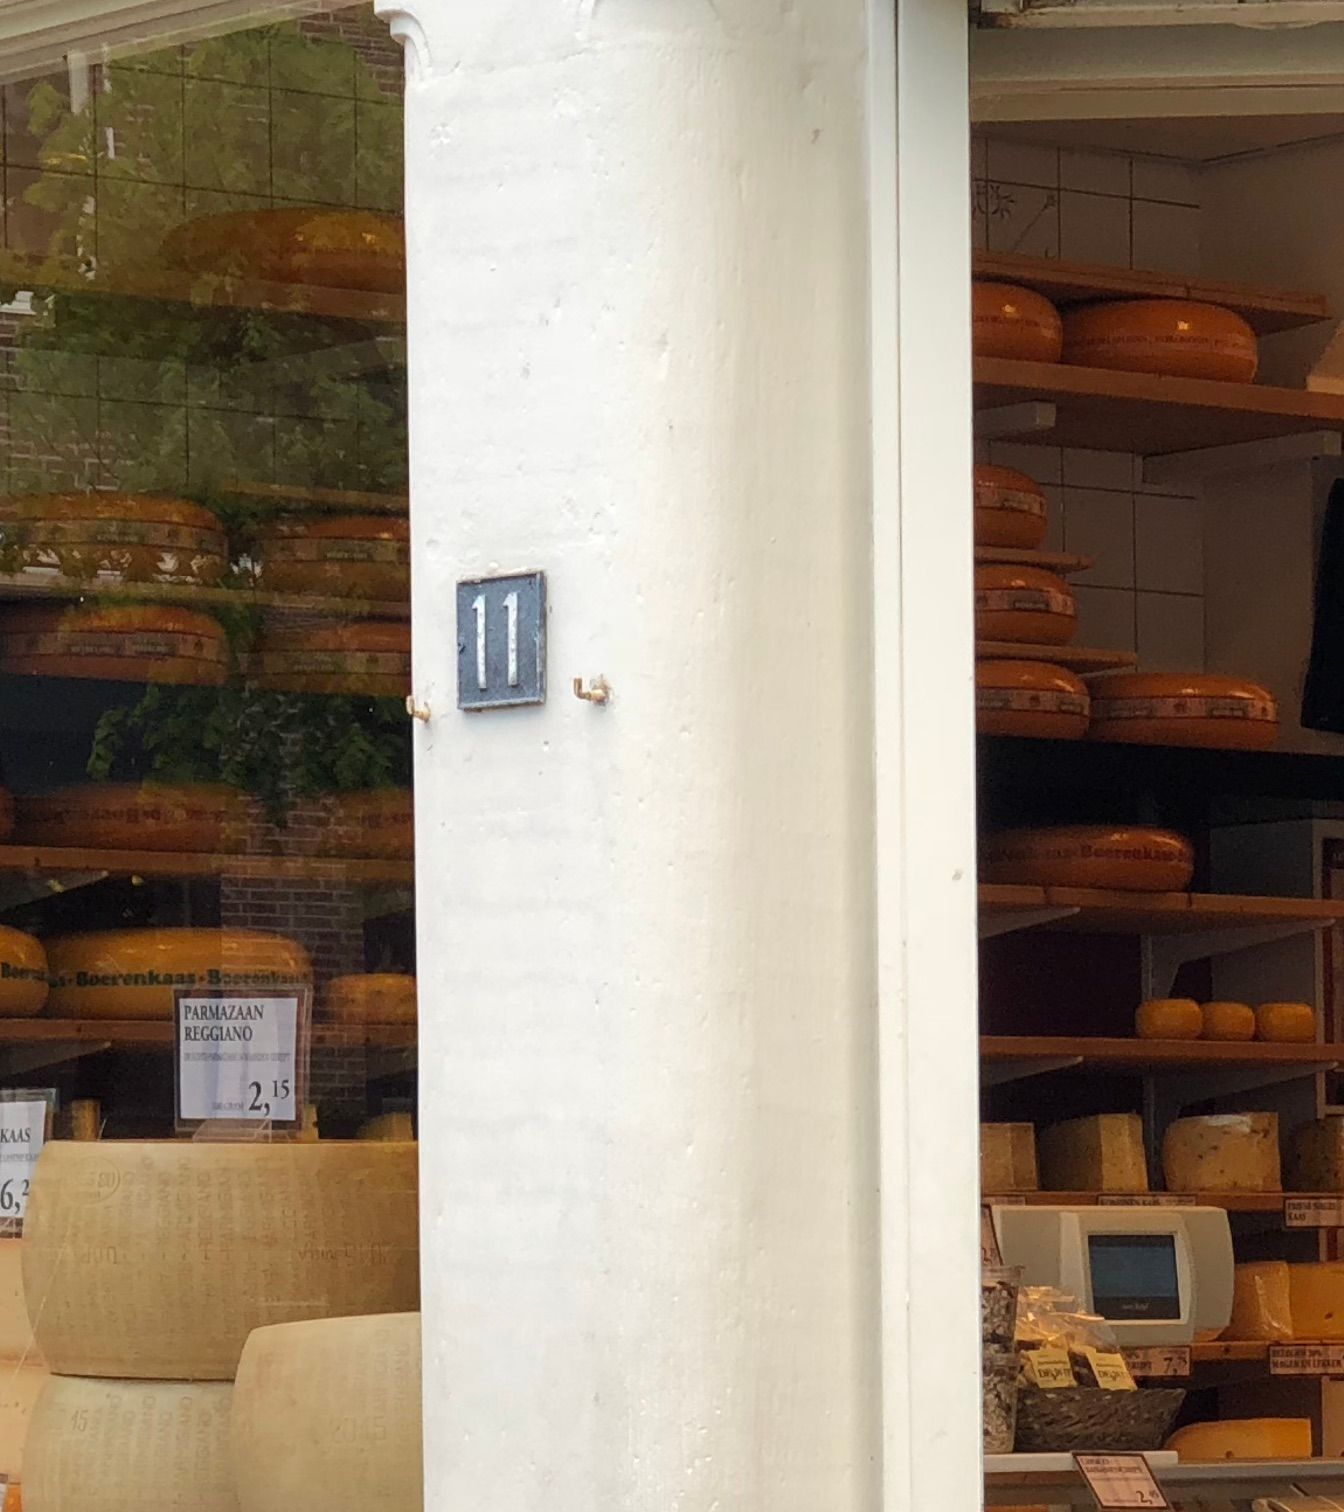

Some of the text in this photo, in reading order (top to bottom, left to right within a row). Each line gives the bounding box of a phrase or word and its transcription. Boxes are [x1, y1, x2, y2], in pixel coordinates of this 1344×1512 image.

[471, 591, 519, 690] 11
[184, 1004, 264, 1021] PARMAZAAN
[184, 1025, 254, 1042] REGGIANO
[248, 1079, 291, 1117] 2,15
[0, 1127, 31, 1144] KAAS
